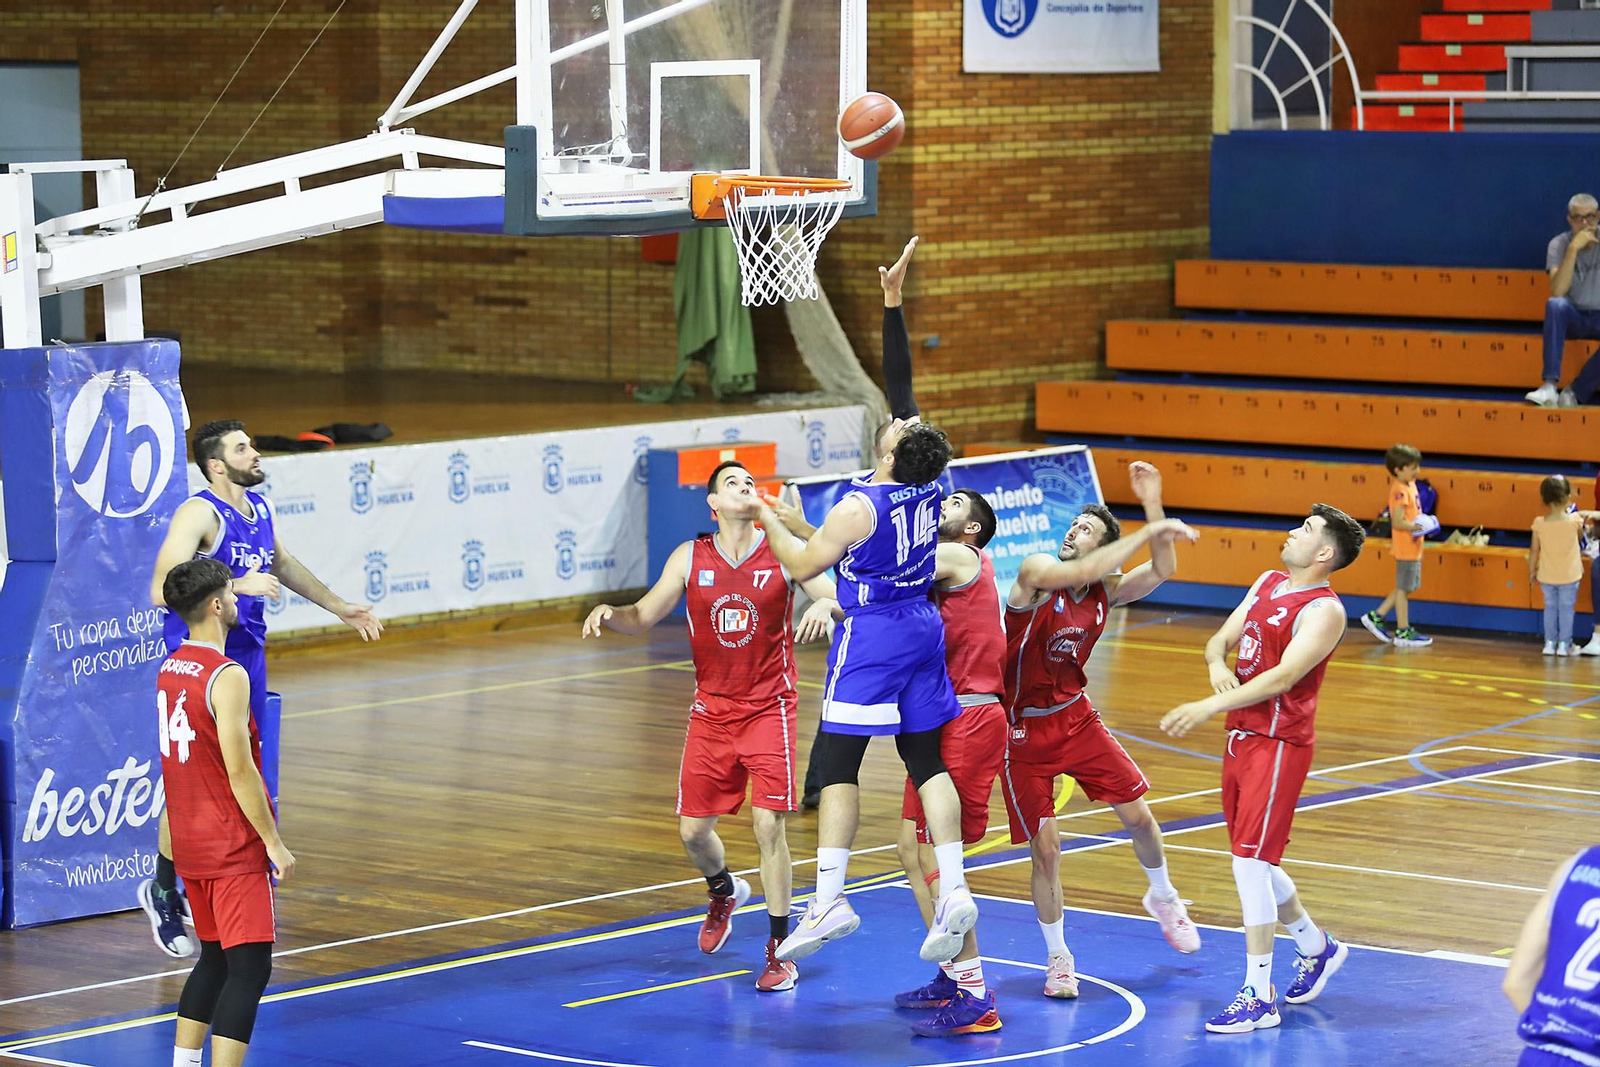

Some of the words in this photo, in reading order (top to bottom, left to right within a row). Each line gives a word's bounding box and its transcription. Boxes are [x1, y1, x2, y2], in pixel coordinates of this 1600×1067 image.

[1490, 342, 1504, 352] 69
[1423, 408, 1437, 418] 69
[1485, 410, 1498, 421] 67
[567, 474, 603, 486] HUELVA
[1352, 474, 1366, 484] 69
[473, 482, 511, 495] HUELVA
[377, 492, 415, 504] HUELVA
[889, 492, 938, 567] 14
[579, 558, 616, 571] HUELVA
[488, 568, 524, 581] HUELVA
[753, 569, 773, 590] 17
[390, 579, 430, 593] HUELVA
[1266, 606, 1288, 627] 2
[50, 622, 74, 652] Tu
[79, 617, 121, 648] ropa
[157, 688, 197, 764] 14
